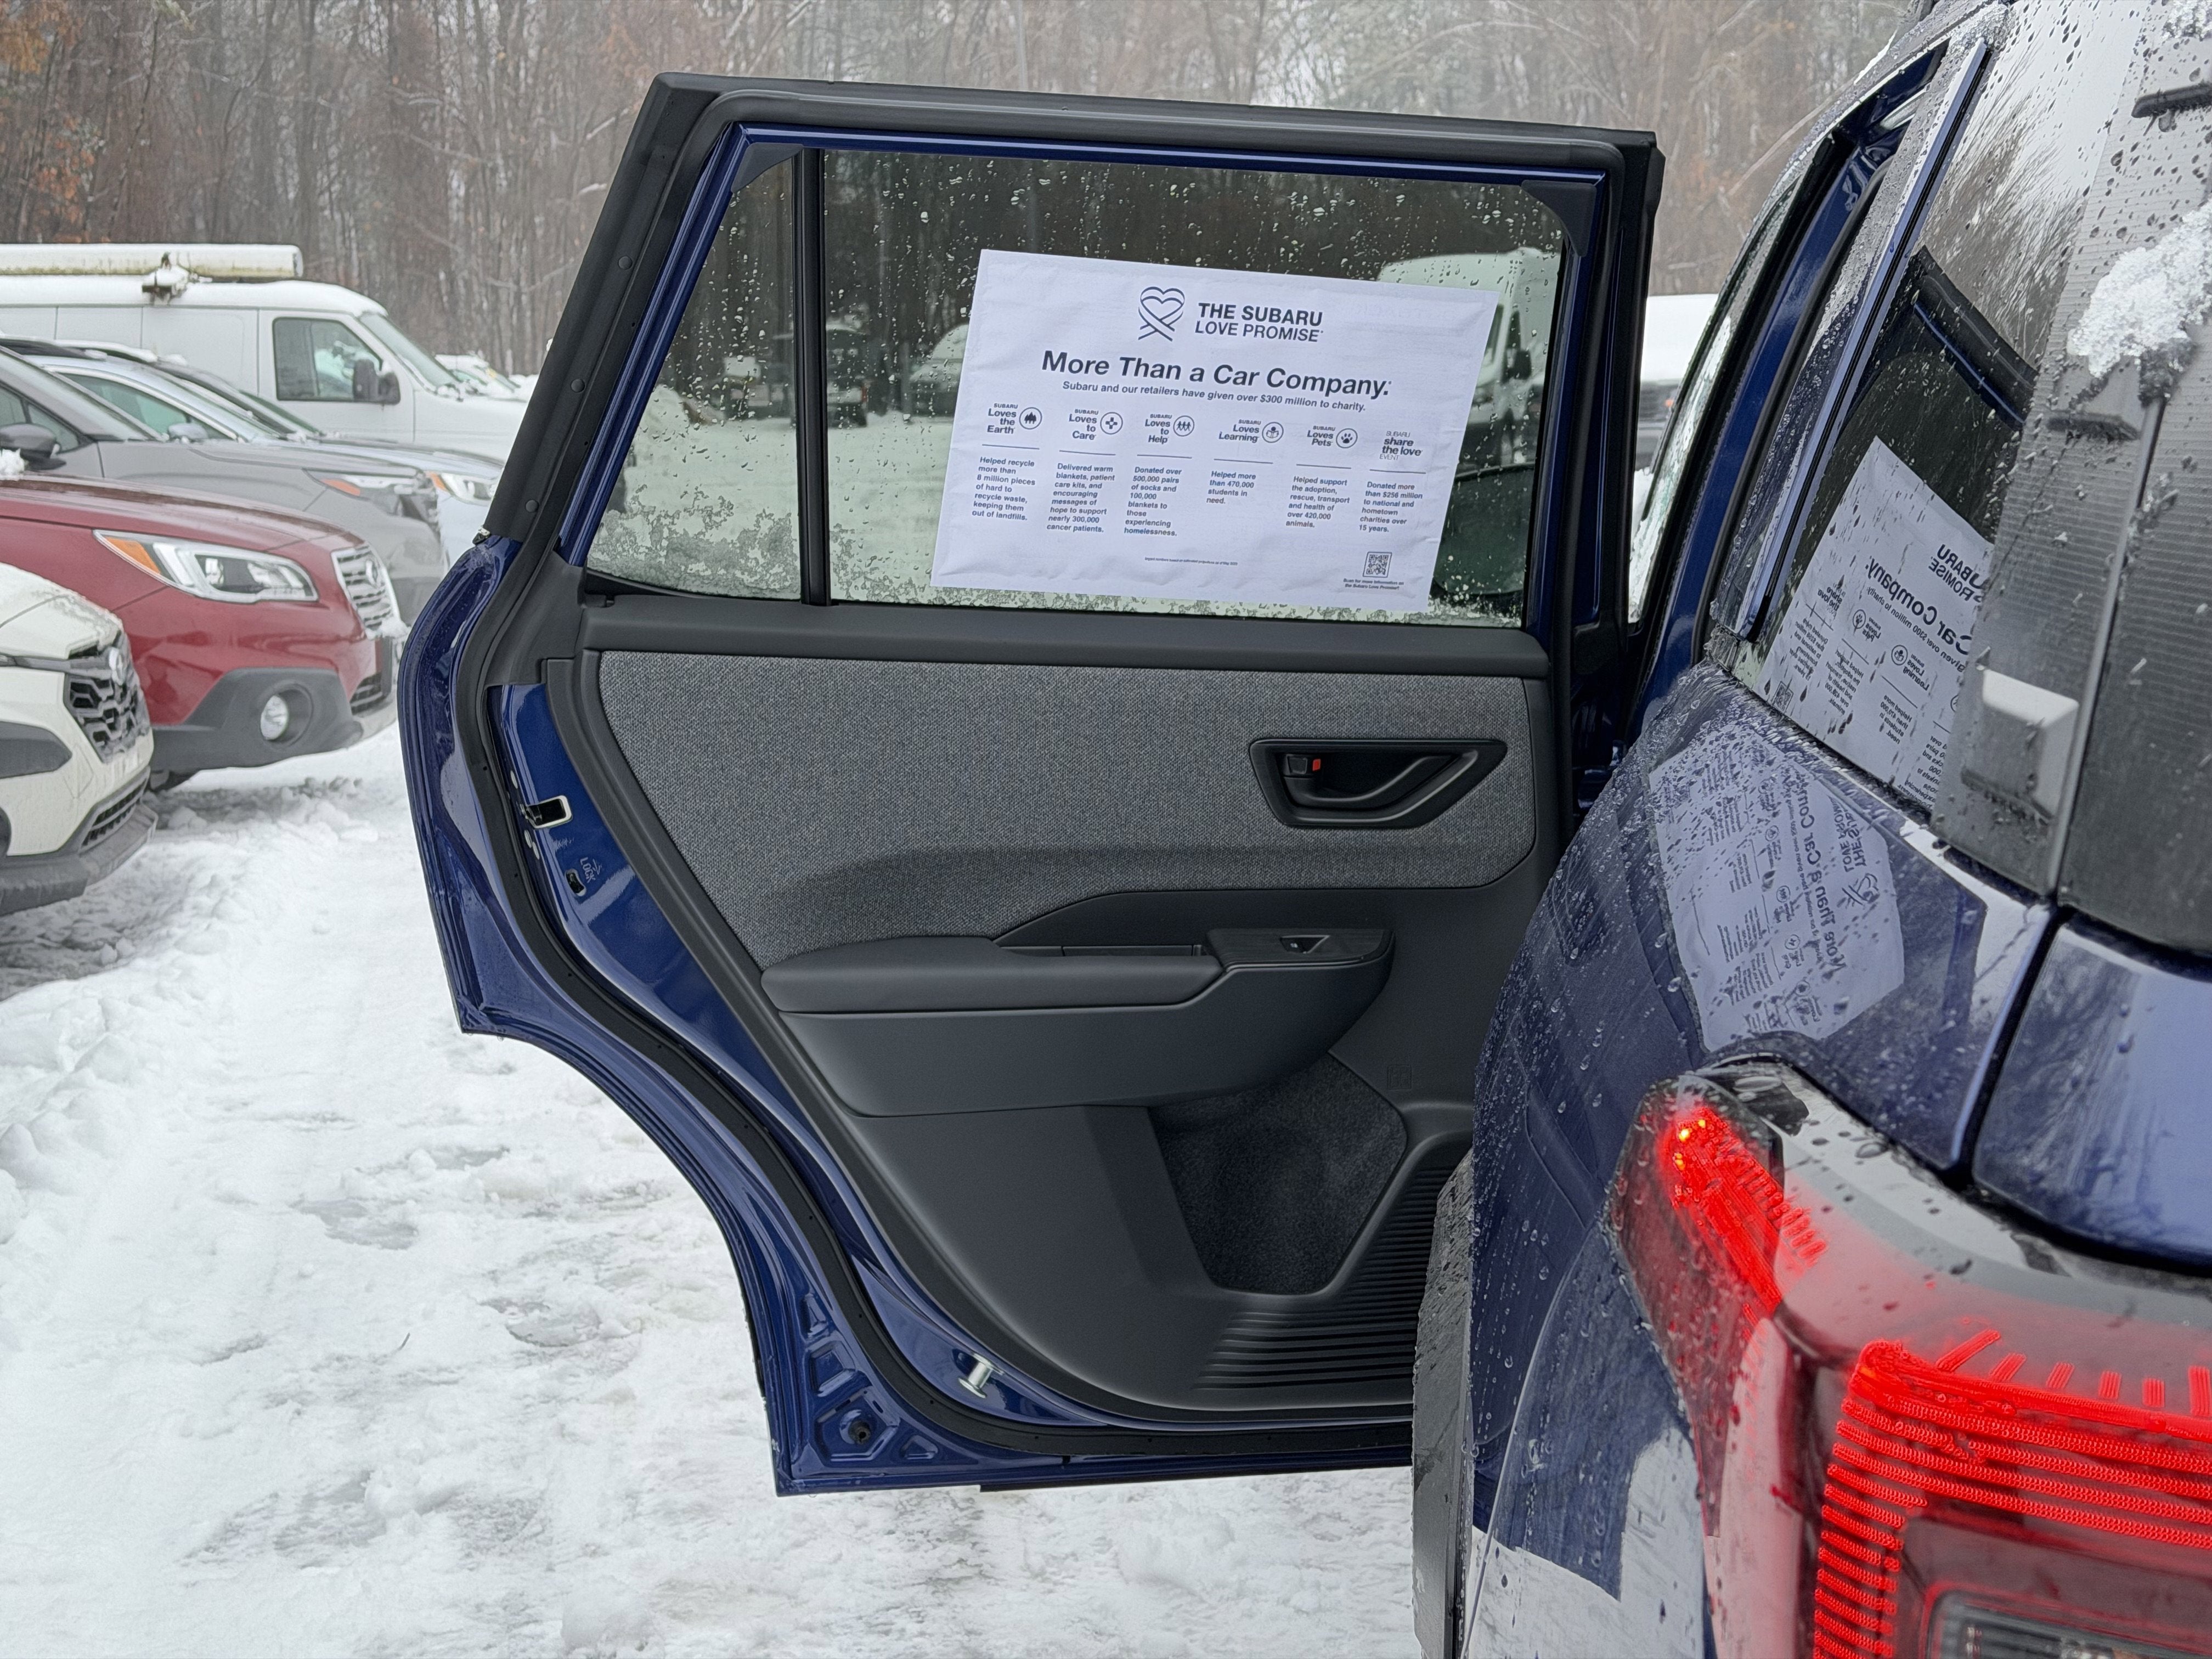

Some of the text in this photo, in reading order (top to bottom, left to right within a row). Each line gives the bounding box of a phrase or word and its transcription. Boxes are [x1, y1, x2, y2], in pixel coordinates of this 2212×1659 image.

[1198, 302, 1323, 326] THE SUBARU
[1195, 321, 1237, 336] LOVE
[1042, 351, 1389, 399] More Than a Car Company.
[1063, 381, 1098, 392] Subaru
[1101, 383, 1119, 393] and
[1122, 385, 1137, 393] our
[1141, 385, 1180, 396] retailers
[1182, 388, 1205, 398] have
[1208, 390, 1234, 401] given
[1237, 393, 1257, 402] over
[1260, 394, 1283, 404] $300
[1285, 397, 1317, 407] million
[1332, 400, 1365, 411] charity.
[988, 408, 1017, 417] Loves
[1069, 414, 1097, 424] Loves
[1145, 419, 1170, 427] Loves
[987, 425, 1014, 434] Earth
[1233, 424, 1260, 433] Loves
[1073, 431, 1094, 440] Care
[1219, 432, 1258, 443] Learning
[1307, 430, 1333, 439] Loves
[1148, 435, 1167, 444] Help
[1312, 438, 1331, 447] Pets
[1384, 438, 1414, 447] share
[1383, 446, 1421, 456] the love
[980, 456, 1006, 466] Helped
[1057, 463, 1092, 471] Delivered
[984, 475, 1008, 483] million
[1056, 472, 1088, 481] blankets,
[1211, 471, 1236, 479] Helped
[1294, 476, 1318, 484] Helped
[1305, 486, 1338, 494] adoption,
[1367, 482, 1396, 490] Donated
[975, 493, 1001, 502] recycle
[1318, 495, 1350, 504] transport
[974, 501, 1003, 511] keeping
[1362, 507, 1398, 516] hometown
[996, 512, 1027, 521] landfills.
[1125, 519, 1171, 528] experiencing
[1124, 527, 1177, 537] homelessness.
[580, 857, 596, 883] LOCK
